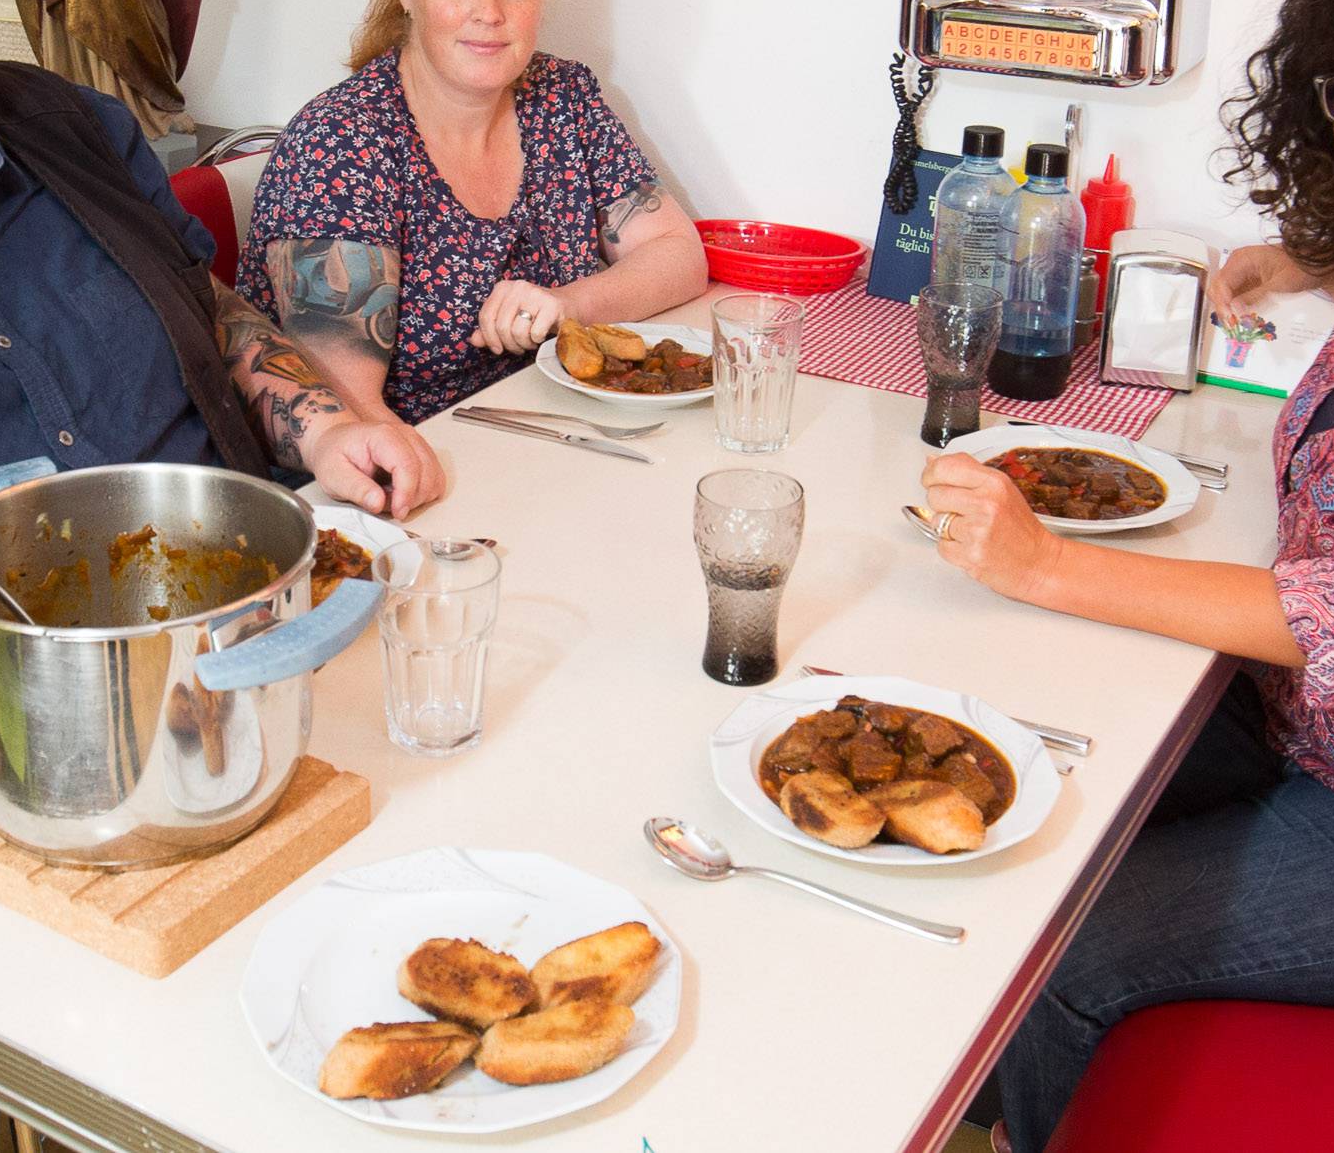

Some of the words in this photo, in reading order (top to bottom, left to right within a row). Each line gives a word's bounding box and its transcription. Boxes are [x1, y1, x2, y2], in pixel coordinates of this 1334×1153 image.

[944, 25, 954, 36] A
[960, 25, 969, 37] B
[974, 27, 984, 39] C
[990, 29, 999, 40] D
[1005, 30, 1014, 42] E
[1020, 31, 1029, 43] F
[1035, 33, 1045, 46] G
[1050, 34, 1060, 46] H
[1067, 36, 1075, 49] J
[1081, 38, 1091, 50] K
[946, 42, 951, 53] 1
[959, 43, 967, 55] 2
[974, 45, 981, 56] 3
[988, 46, 997, 57] 4
[1004, 47, 1012, 59] 5
[1019, 49, 1026, 61] 6
[1035, 51, 1042, 62] 7
[1049, 52, 1057, 64] 8
[1065, 53, 1073, 65] 9
[1079, 55, 1091, 67] 10
[899, 222, 917, 237] Du
[919, 226, 935, 241] bis
[895, 237, 930, 254] täglich
